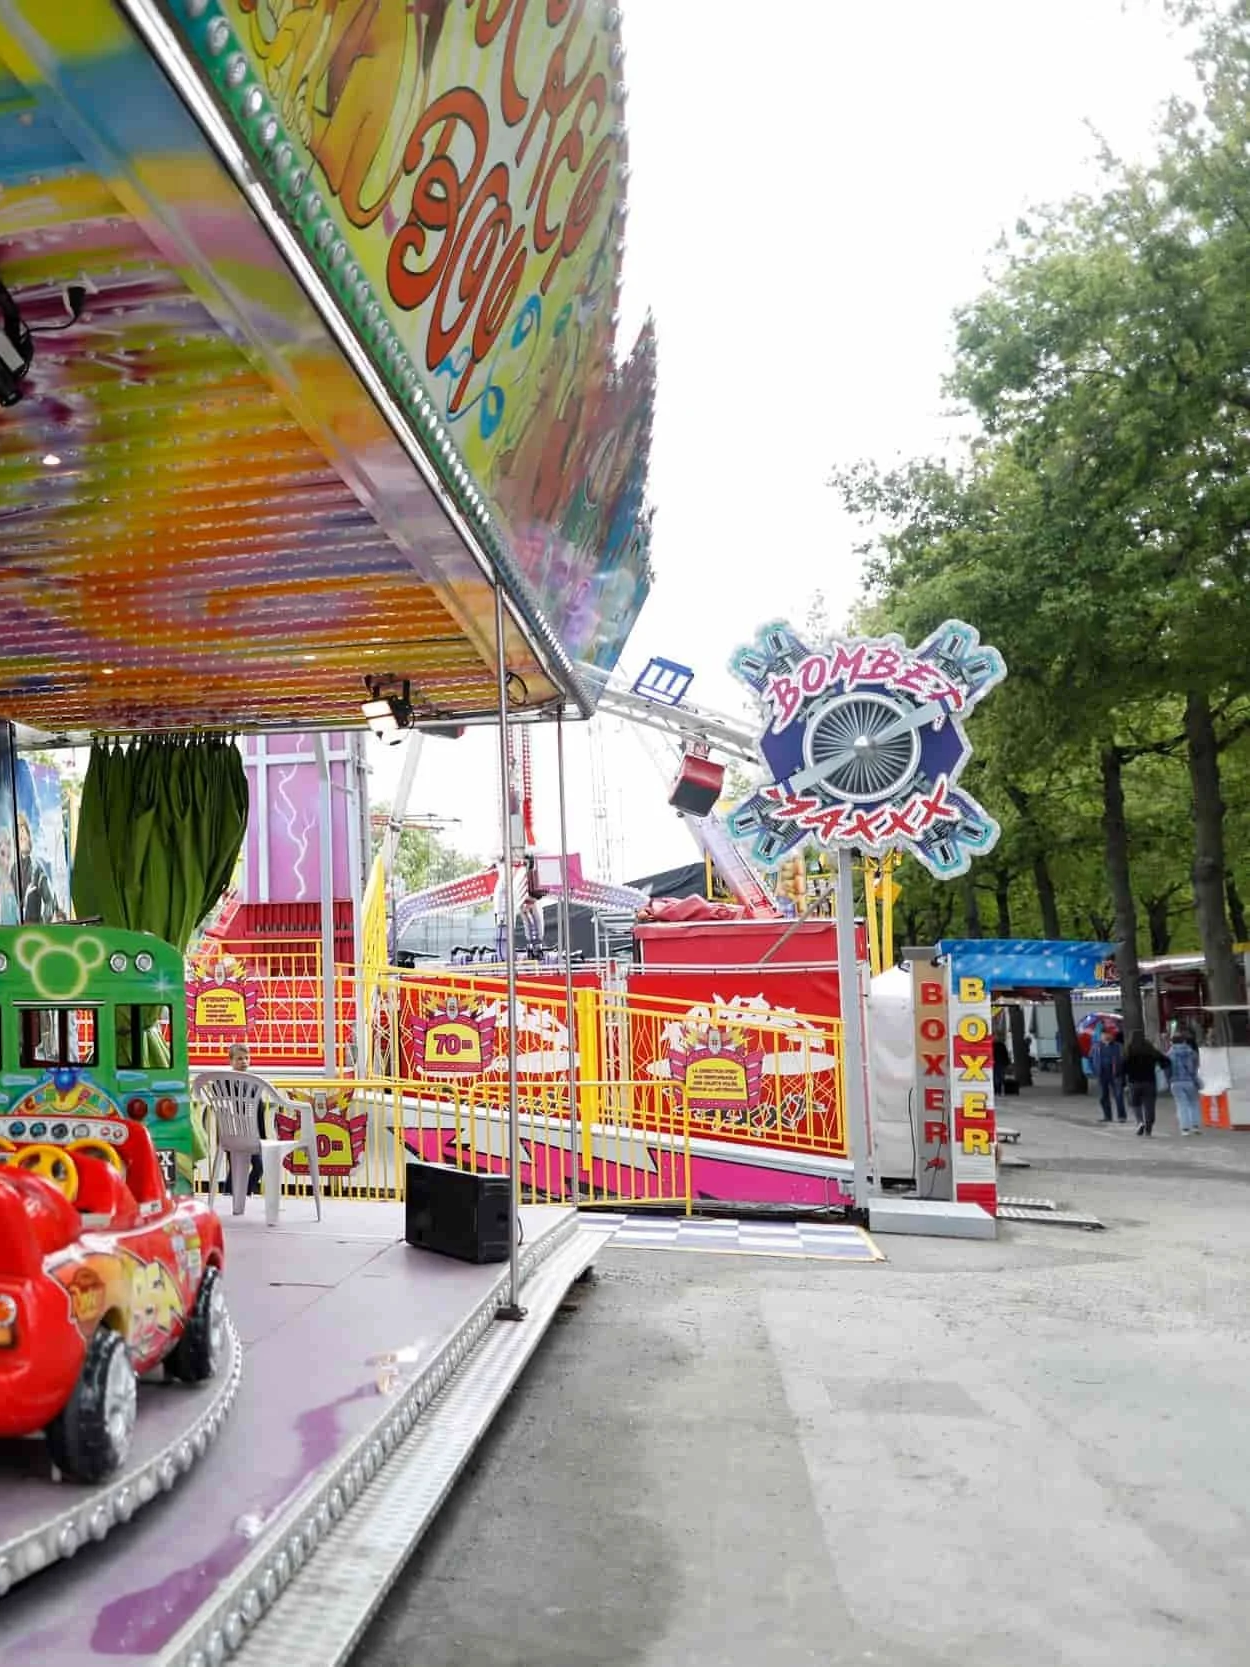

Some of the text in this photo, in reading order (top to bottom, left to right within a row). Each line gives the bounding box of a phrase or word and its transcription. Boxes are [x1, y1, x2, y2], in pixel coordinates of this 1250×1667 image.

[464, 0, 616, 297] CKEY
[920, 982, 948, 1145] BOXER
[957, 976, 992, 1155] BOXER
